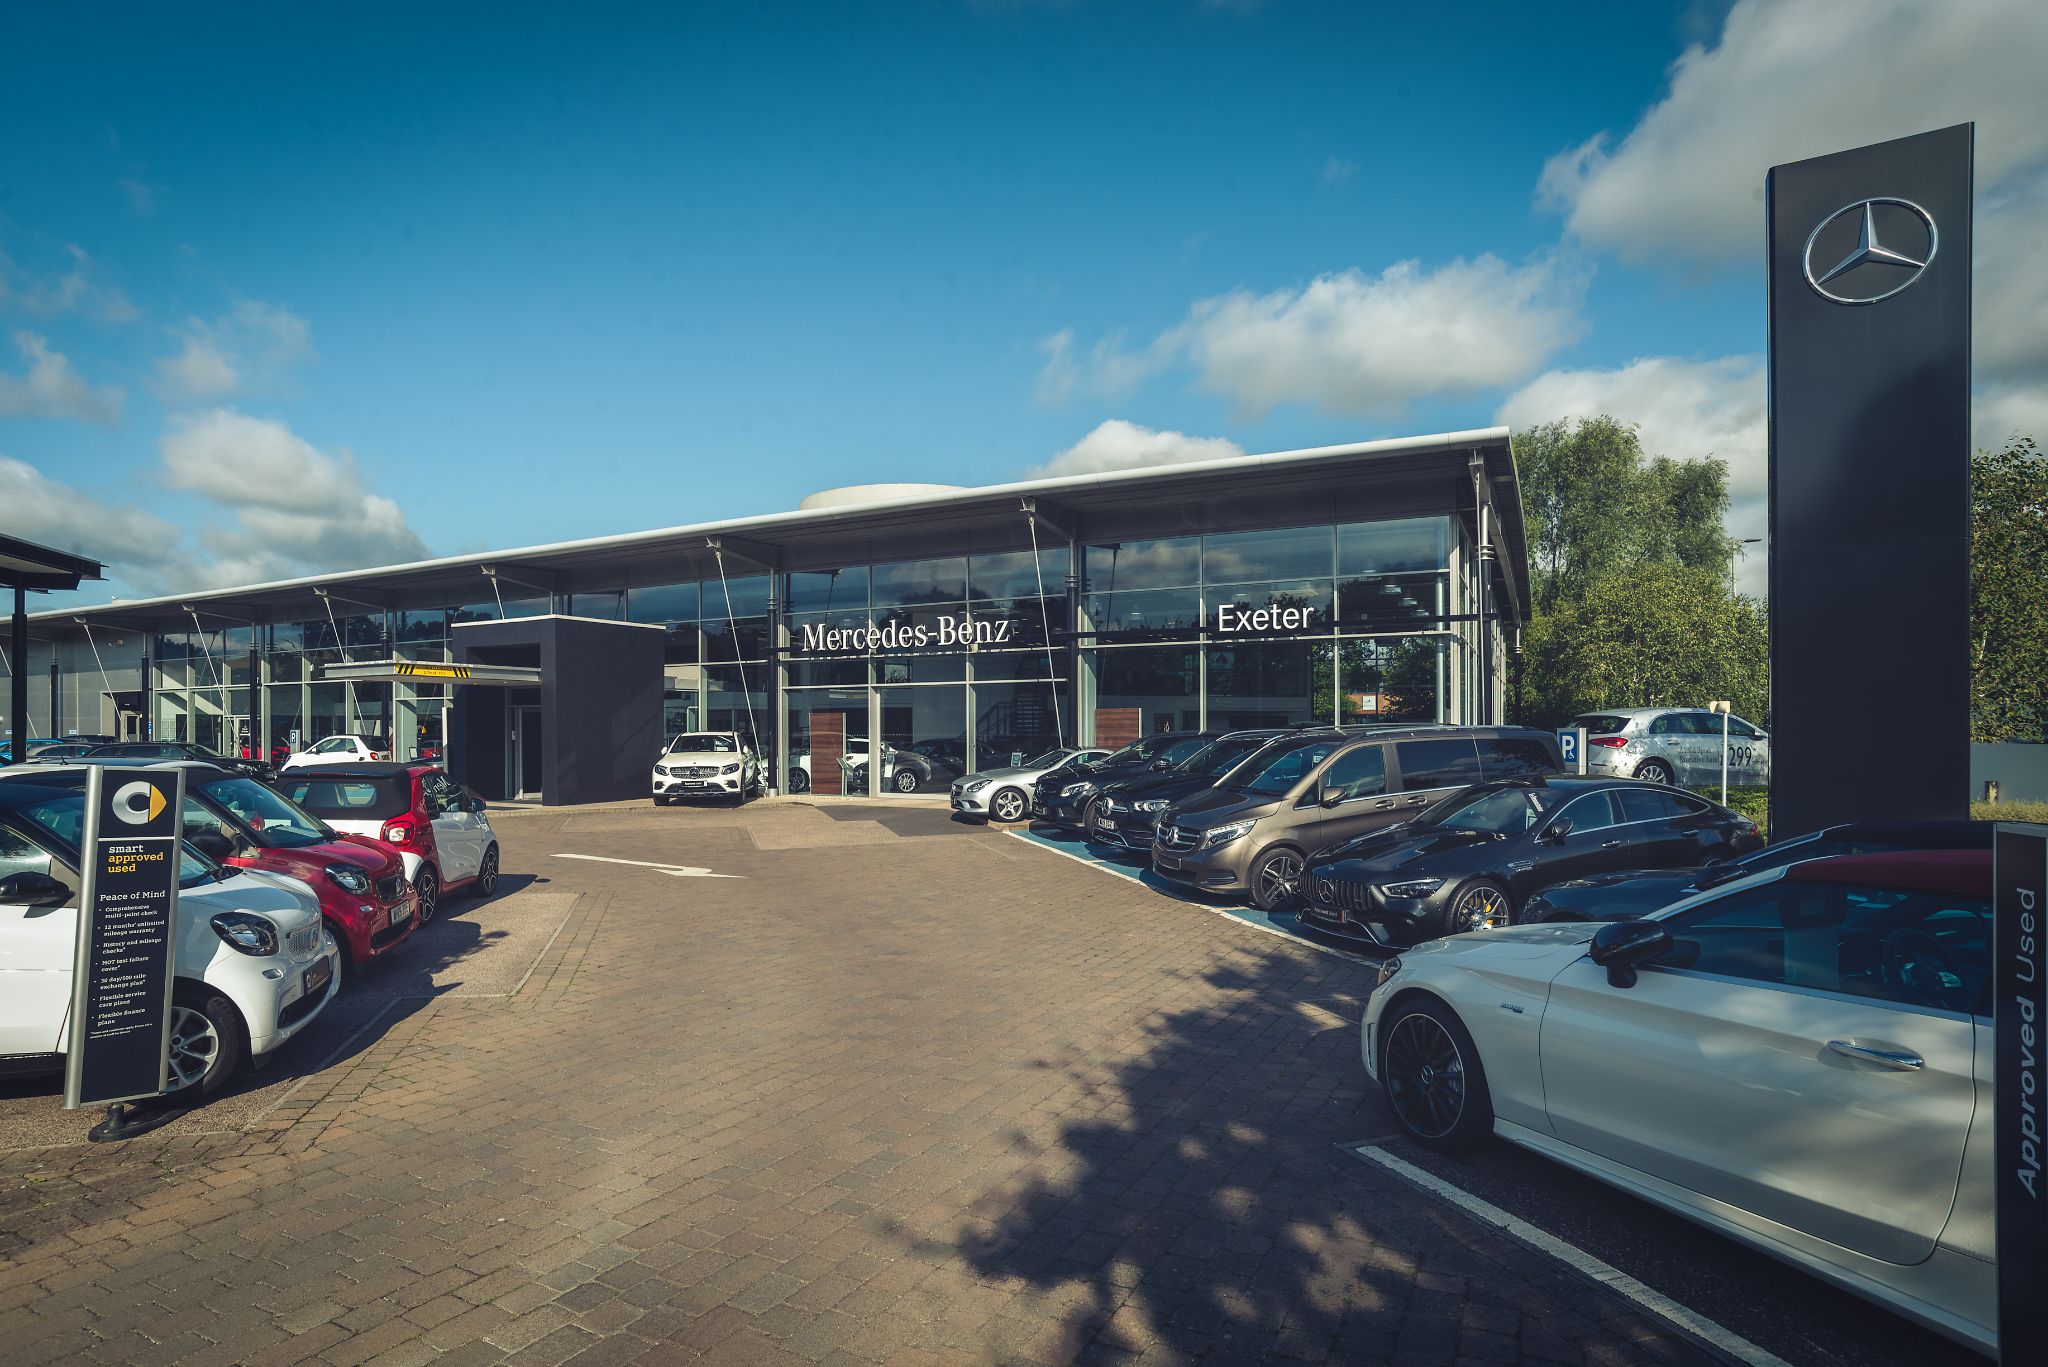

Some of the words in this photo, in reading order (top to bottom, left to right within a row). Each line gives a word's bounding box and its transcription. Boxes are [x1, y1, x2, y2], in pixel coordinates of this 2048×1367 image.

[1218, 603, 1315, 632] Exeter
[801, 615, 1011, 652] Mercedes-Benz
[1562, 735, 1575, 759] P
[108, 844, 144, 854] smart
[108, 851, 164, 864] approved
[107, 863, 137, 873] used
[99, 893, 128, 902] Peace
[130, 891, 140, 900] of
[142, 889, 166, 899] Mind
[105, 904, 150, 913] Comprehensive
[104, 911, 140, 919] multi-point
[137, 919, 165, 927] unlimited
[103, 929, 128, 937] mileage
[2016, 887, 2035, 983] Used
[100, 982, 129, 990] exchange
[99, 993, 124, 1001] Flexible
[124, 990, 147, 998] service
[113, 999, 131, 1007] plans
[98, 1011, 123, 1019] Flexible
[123, 1008, 146, 1016] finance
[97, 1019, 116, 1027] plans
[2016, 996, 2041, 1200] Approved
